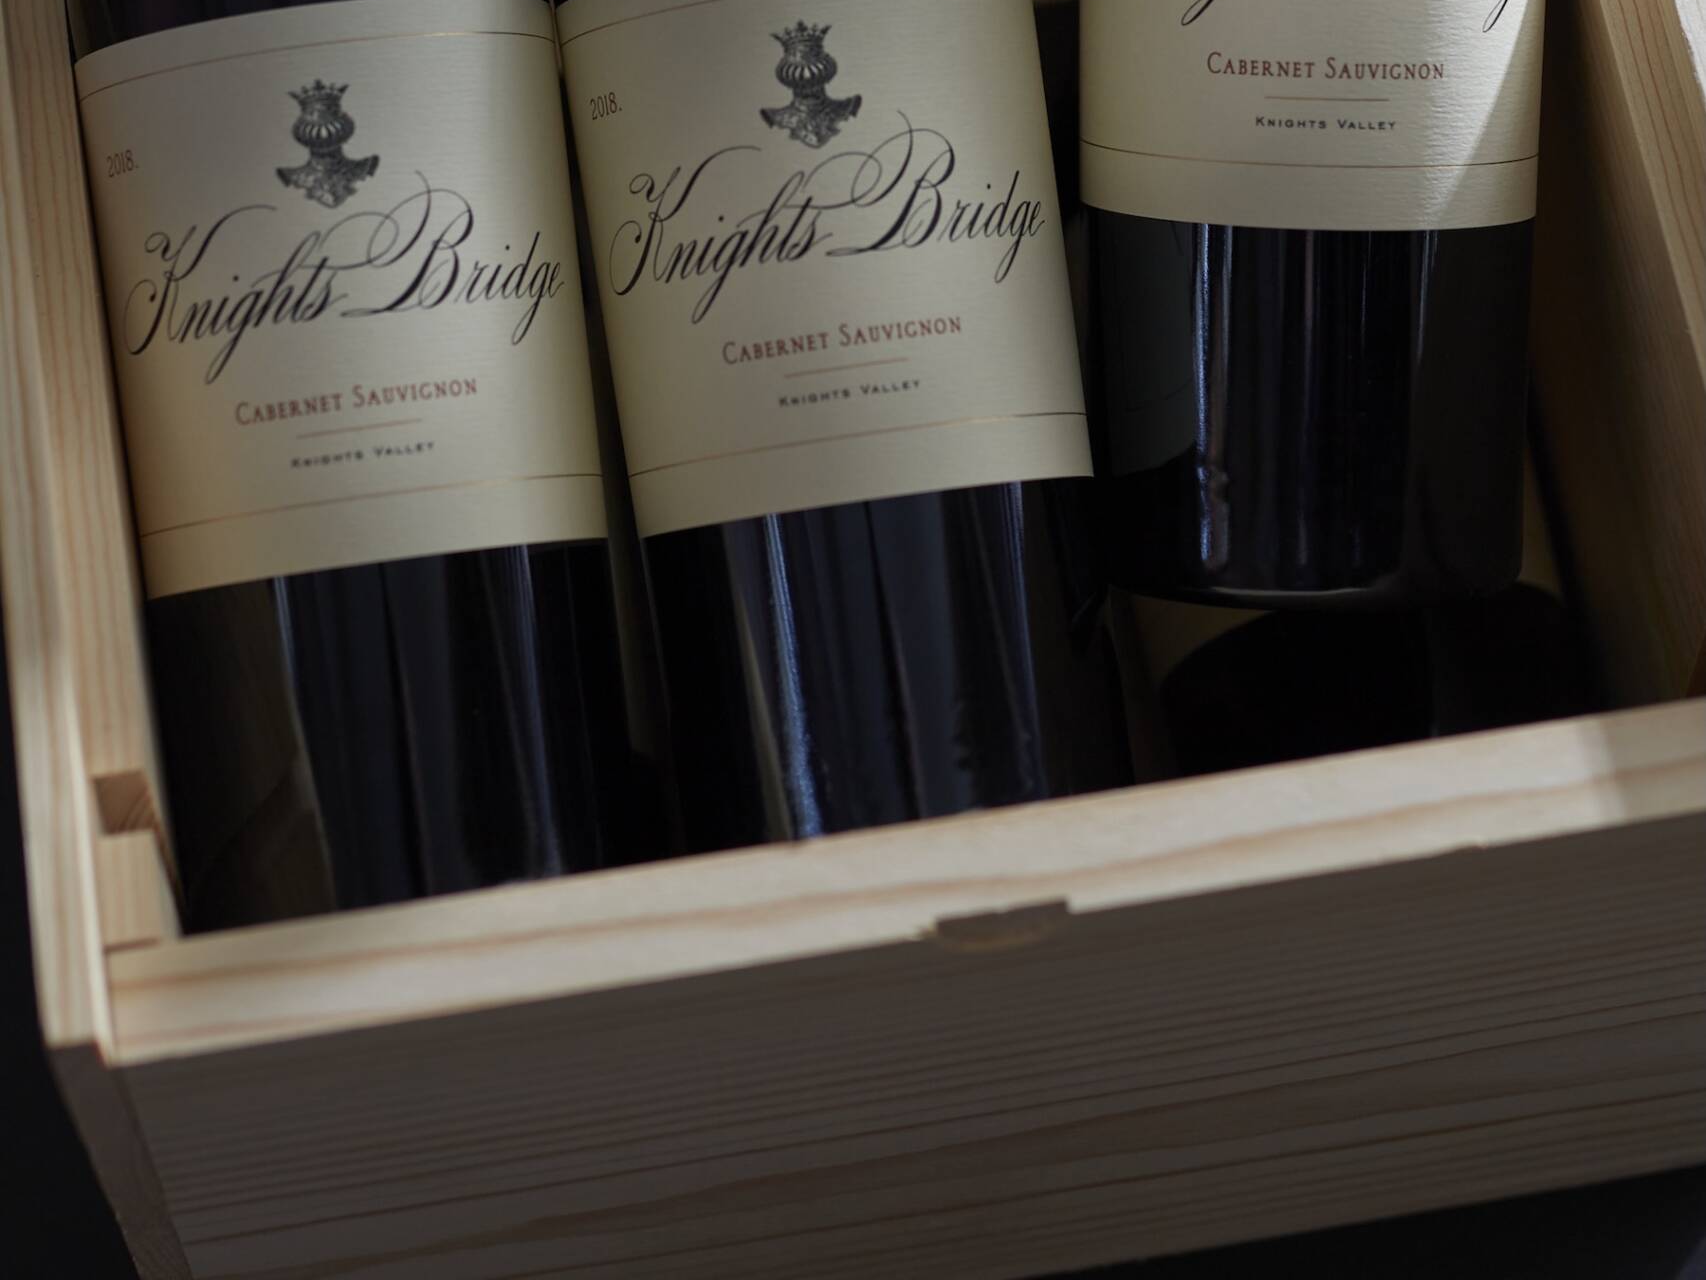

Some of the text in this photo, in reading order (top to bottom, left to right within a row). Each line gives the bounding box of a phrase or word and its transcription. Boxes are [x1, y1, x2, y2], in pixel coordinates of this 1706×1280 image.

[1207, 52, 1444, 79] CABERNET SAUVIGNON
[589, 92, 622, 120] 2018.
[1255, 116, 1396, 130] KNIGHTS VALLEY
[107, 150, 139, 178] 2018.
[609, 110, 1045, 324] Knights Bridge
[124, 171, 565, 384] Knights Bridge
[722, 317, 962, 365] CABERNET SAUVIGNON
[860, 379, 920, 396] VALLEY
[236, 378, 477, 426] CABERNET SAUVIGNON
[373, 440, 435, 458] VALLEY
